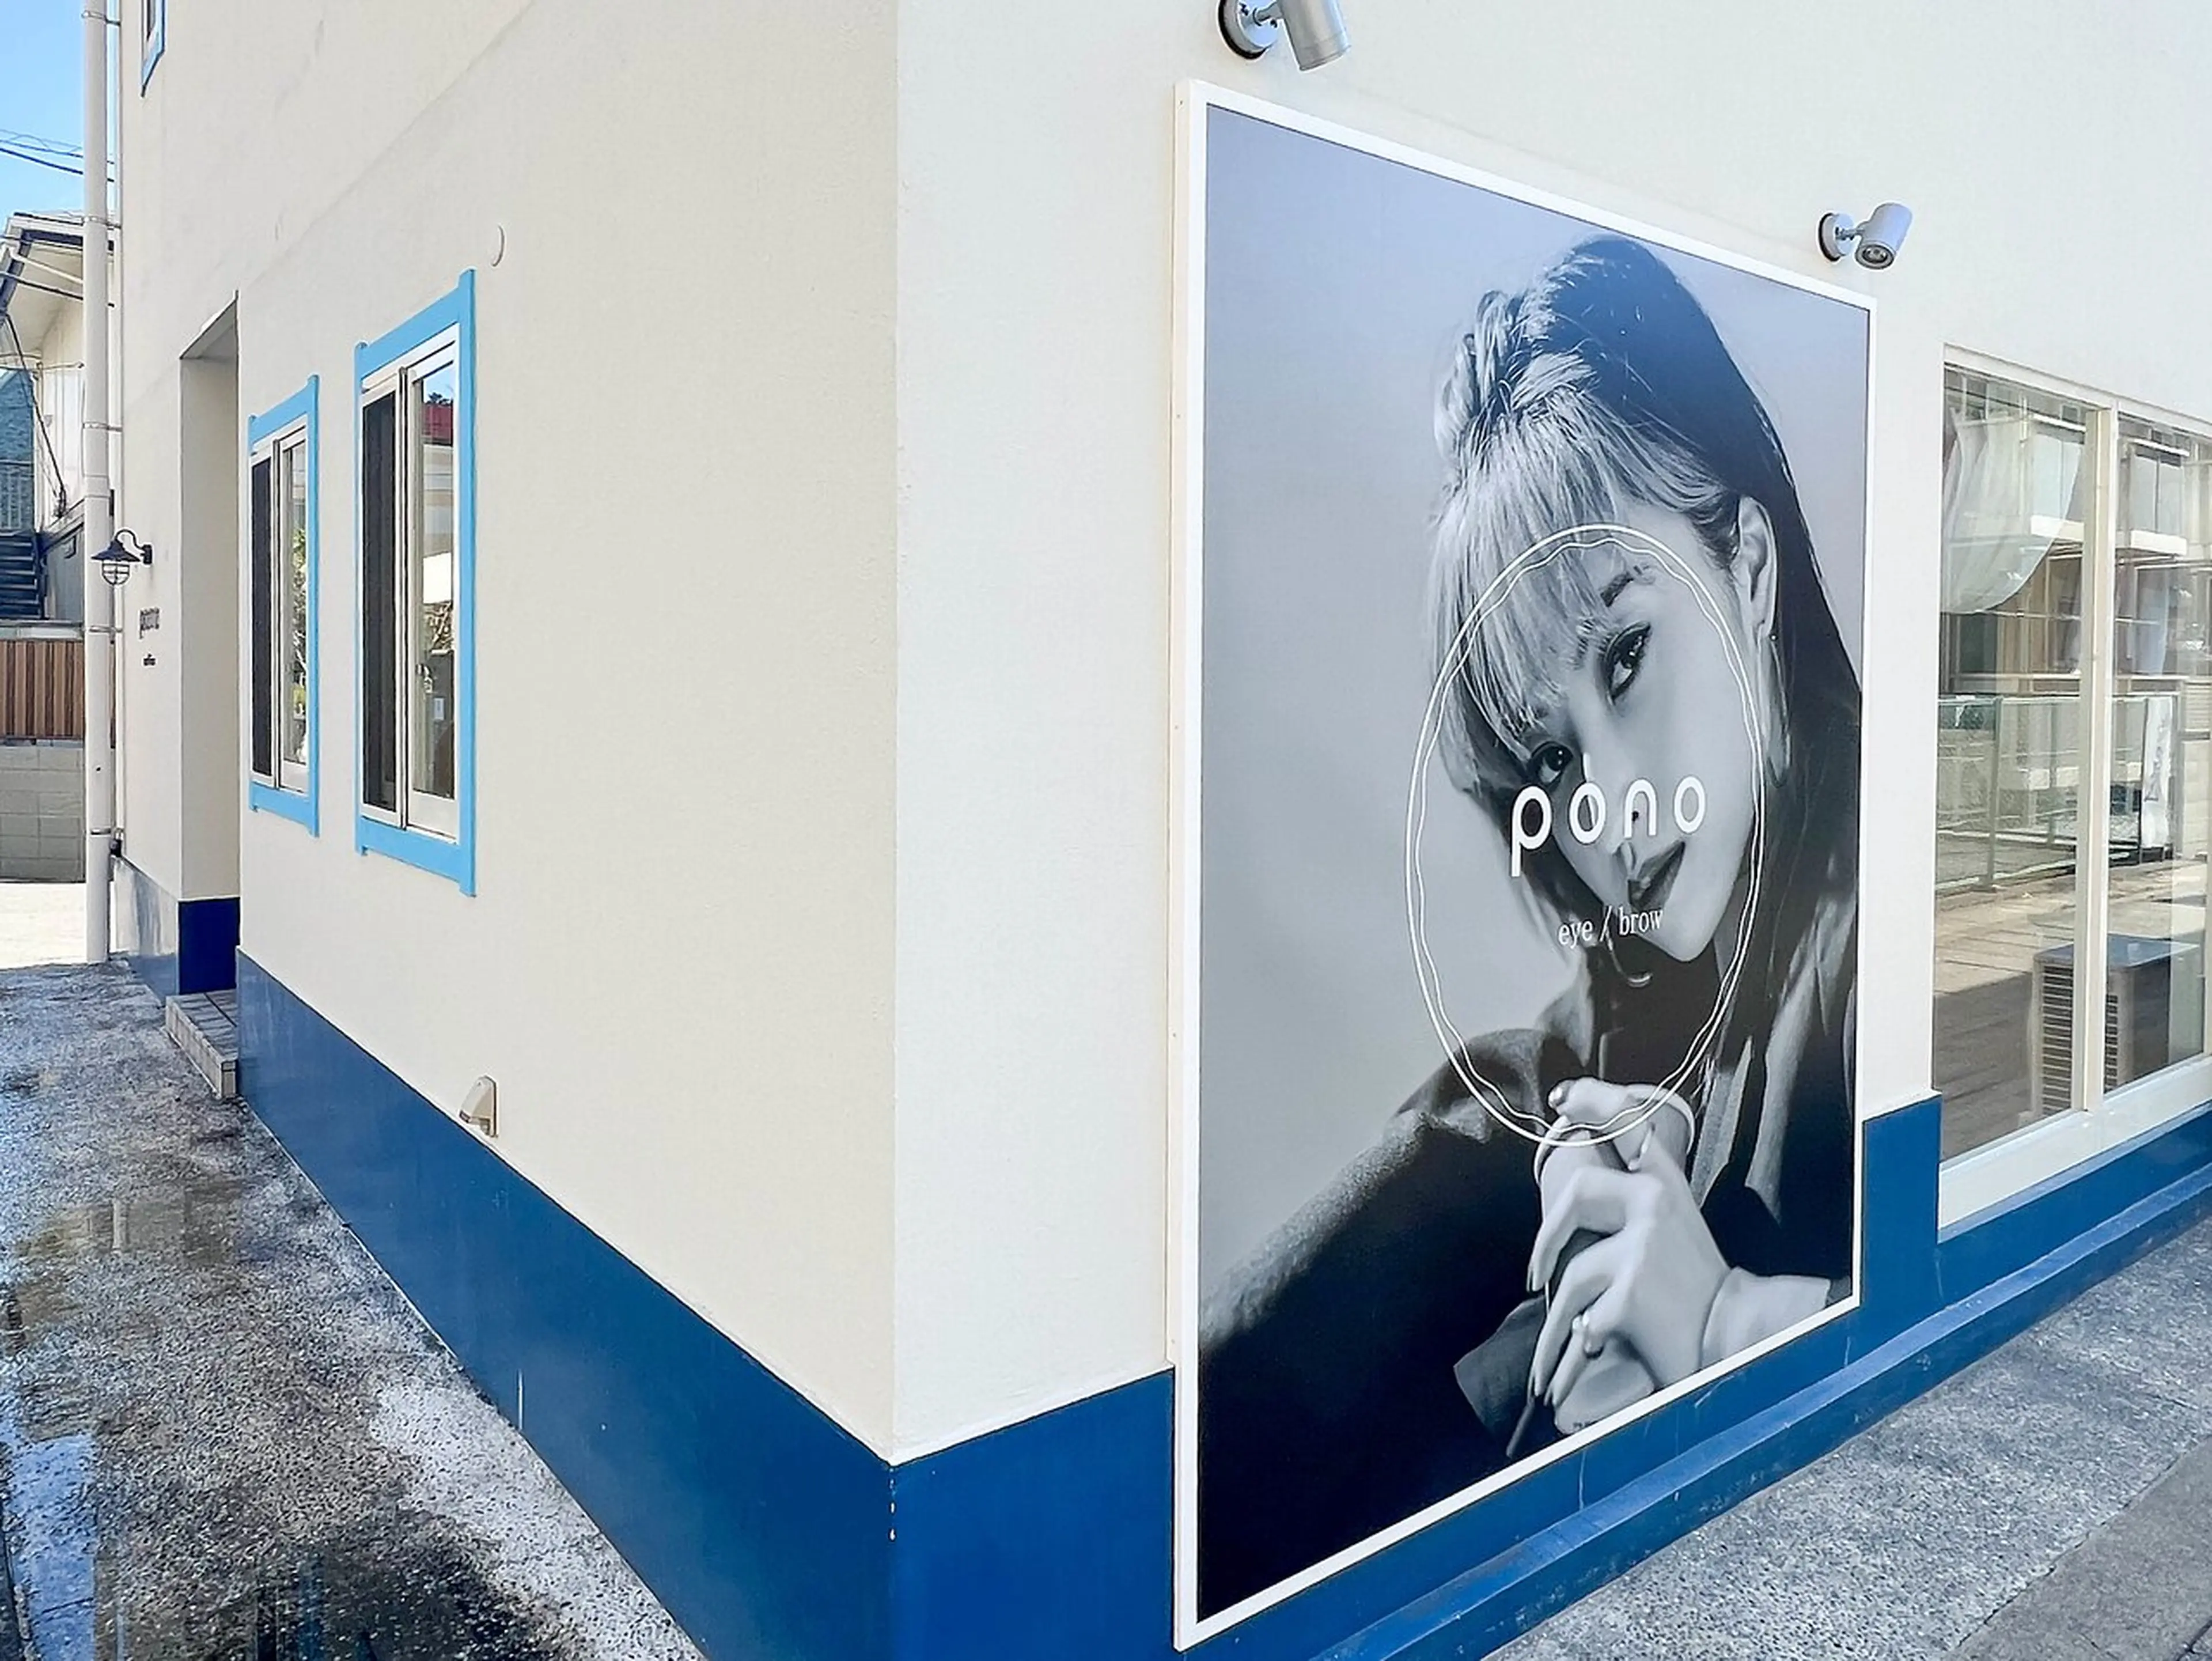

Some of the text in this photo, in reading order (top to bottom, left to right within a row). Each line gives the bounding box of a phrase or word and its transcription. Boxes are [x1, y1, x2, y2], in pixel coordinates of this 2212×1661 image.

[1511, 775, 1706, 877] pono
[1558, 921, 1593, 949] eye
[1619, 906, 1663, 936] brow
